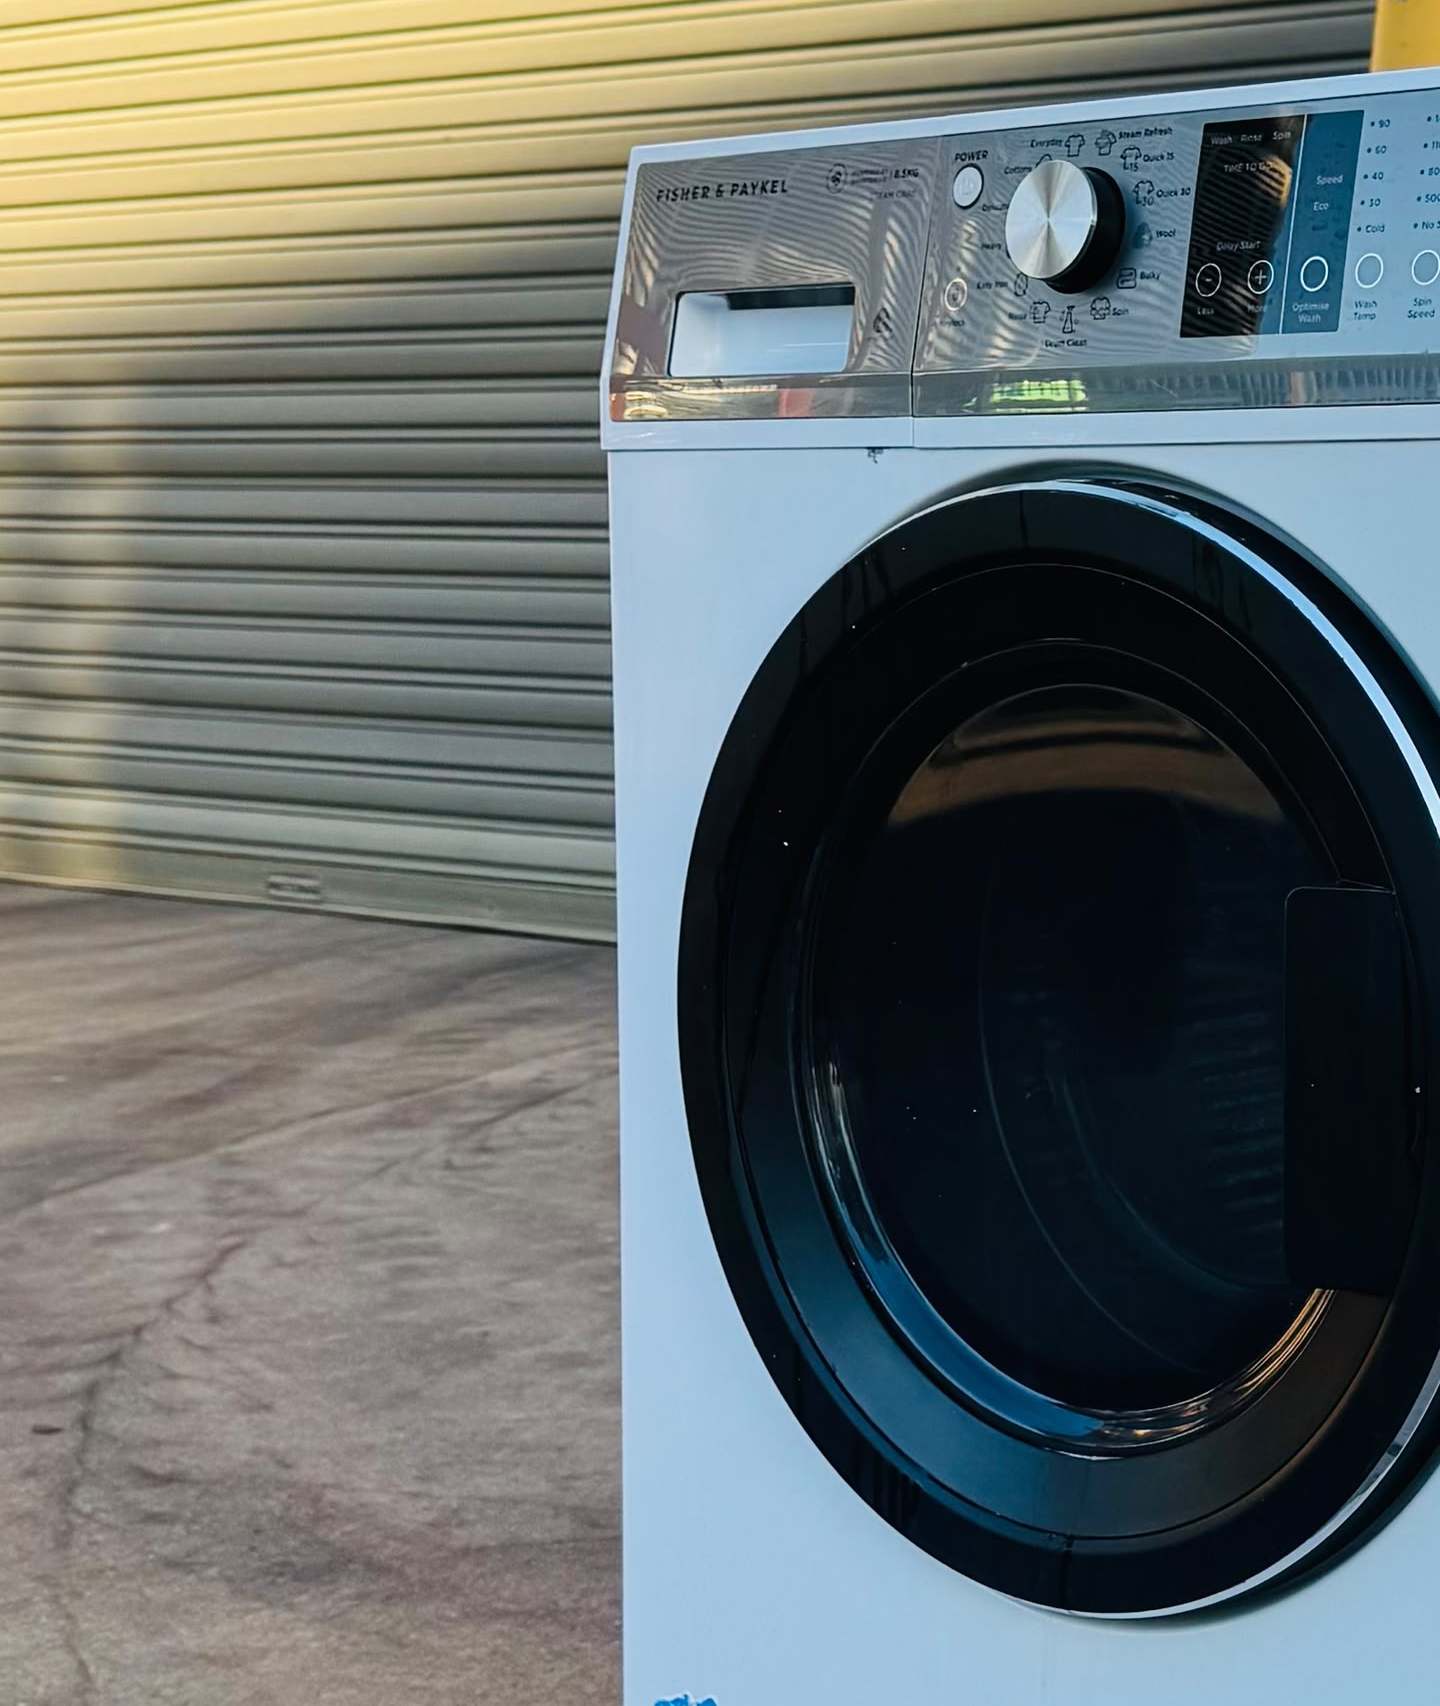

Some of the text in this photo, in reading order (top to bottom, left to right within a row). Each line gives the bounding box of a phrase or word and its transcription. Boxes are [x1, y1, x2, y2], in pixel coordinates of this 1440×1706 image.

[954, 150, 988, 161] POWER
[1316, 175, 1343, 186] Speed
[1371, 171, 1384, 180] 40
[656, 180, 788, 202] FISHER & PAYKEL
[1313, 201, 1329, 211] Eco
[1365, 224, 1385, 233] Cold
[1422, 221, 1434, 230] No
[1413, 297, 1432, 307] Spin
[1298, 313, 1321, 323] Wash
[1407, 309, 1435, 319] Speed
